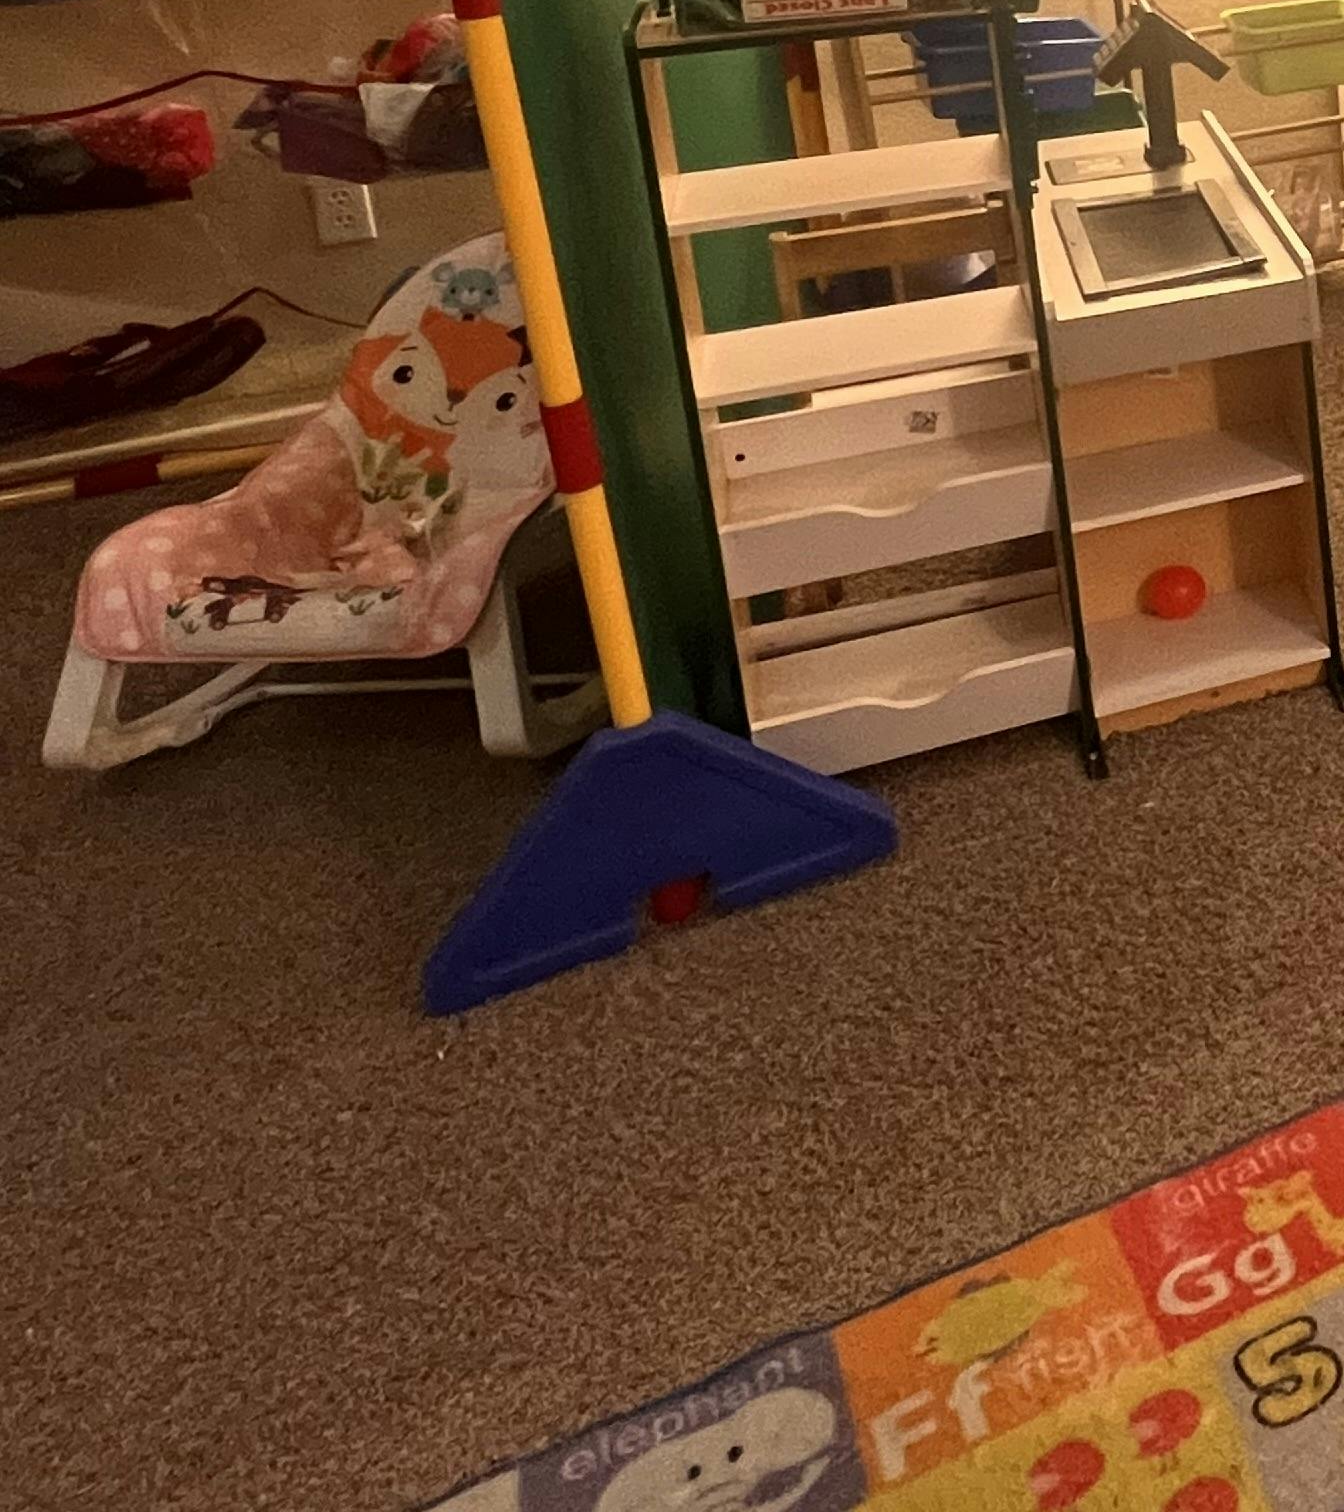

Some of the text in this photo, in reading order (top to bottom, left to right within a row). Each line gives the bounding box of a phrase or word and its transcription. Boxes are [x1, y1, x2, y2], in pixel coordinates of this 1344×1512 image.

[1169, 1129, 1318, 1215] giraffe
[1154, 1232, 1296, 1318] Gg
[562, 1346, 804, 1482] elephant
[867, 1365, 994, 1484] Ff
[1233, 1315, 1343, 1428] 5
